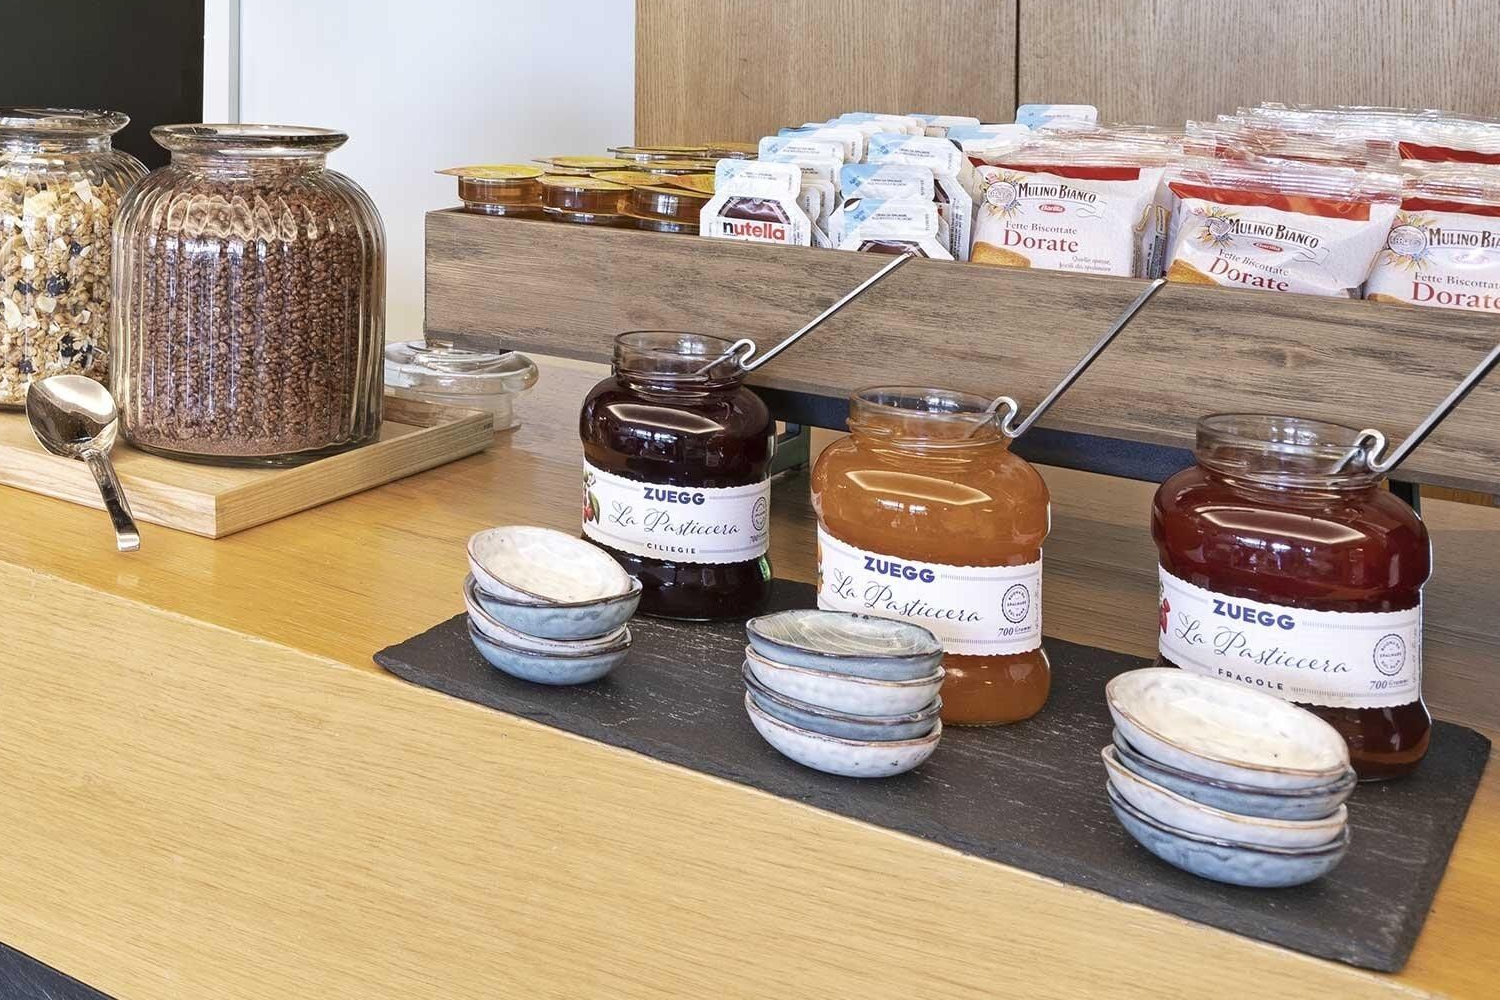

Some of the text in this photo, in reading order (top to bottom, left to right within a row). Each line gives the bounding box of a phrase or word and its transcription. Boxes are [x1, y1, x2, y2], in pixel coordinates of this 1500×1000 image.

[1018, 183, 1097, 204] MULINO BIANCO
[723, 221, 786, 241] nutella
[1006, 220, 1077, 235] Fette Biscottate
[1229, 218, 1319, 249] MULINO BIANCO
[1429, 228, 1479, 247] MULINO
[1004, 229, 1079, 253] Dorate
[1209, 257, 1290, 292] Dorate
[1219, 249, 1289, 276] Fette Biscottate
[1415, 272, 1443, 284] Fette
[643, 487, 706, 506] ZUEGG
[608, 501, 639, 528] La
[643, 507, 741, 537] Pasticcera
[646, 543, 697, 555] CILIEGIE
[863, 555, 936, 583] ZUEGG
[831, 568, 985, 622] La Pasticcera
[1212, 598, 1296, 631] ZUEGG
[997, 626, 1015, 637] 700
[1174, 611, 1354, 674] La Pasticcera
[1217, 667, 1285, 691] FRAGOLE
[1369, 679, 1388, 690] 700
